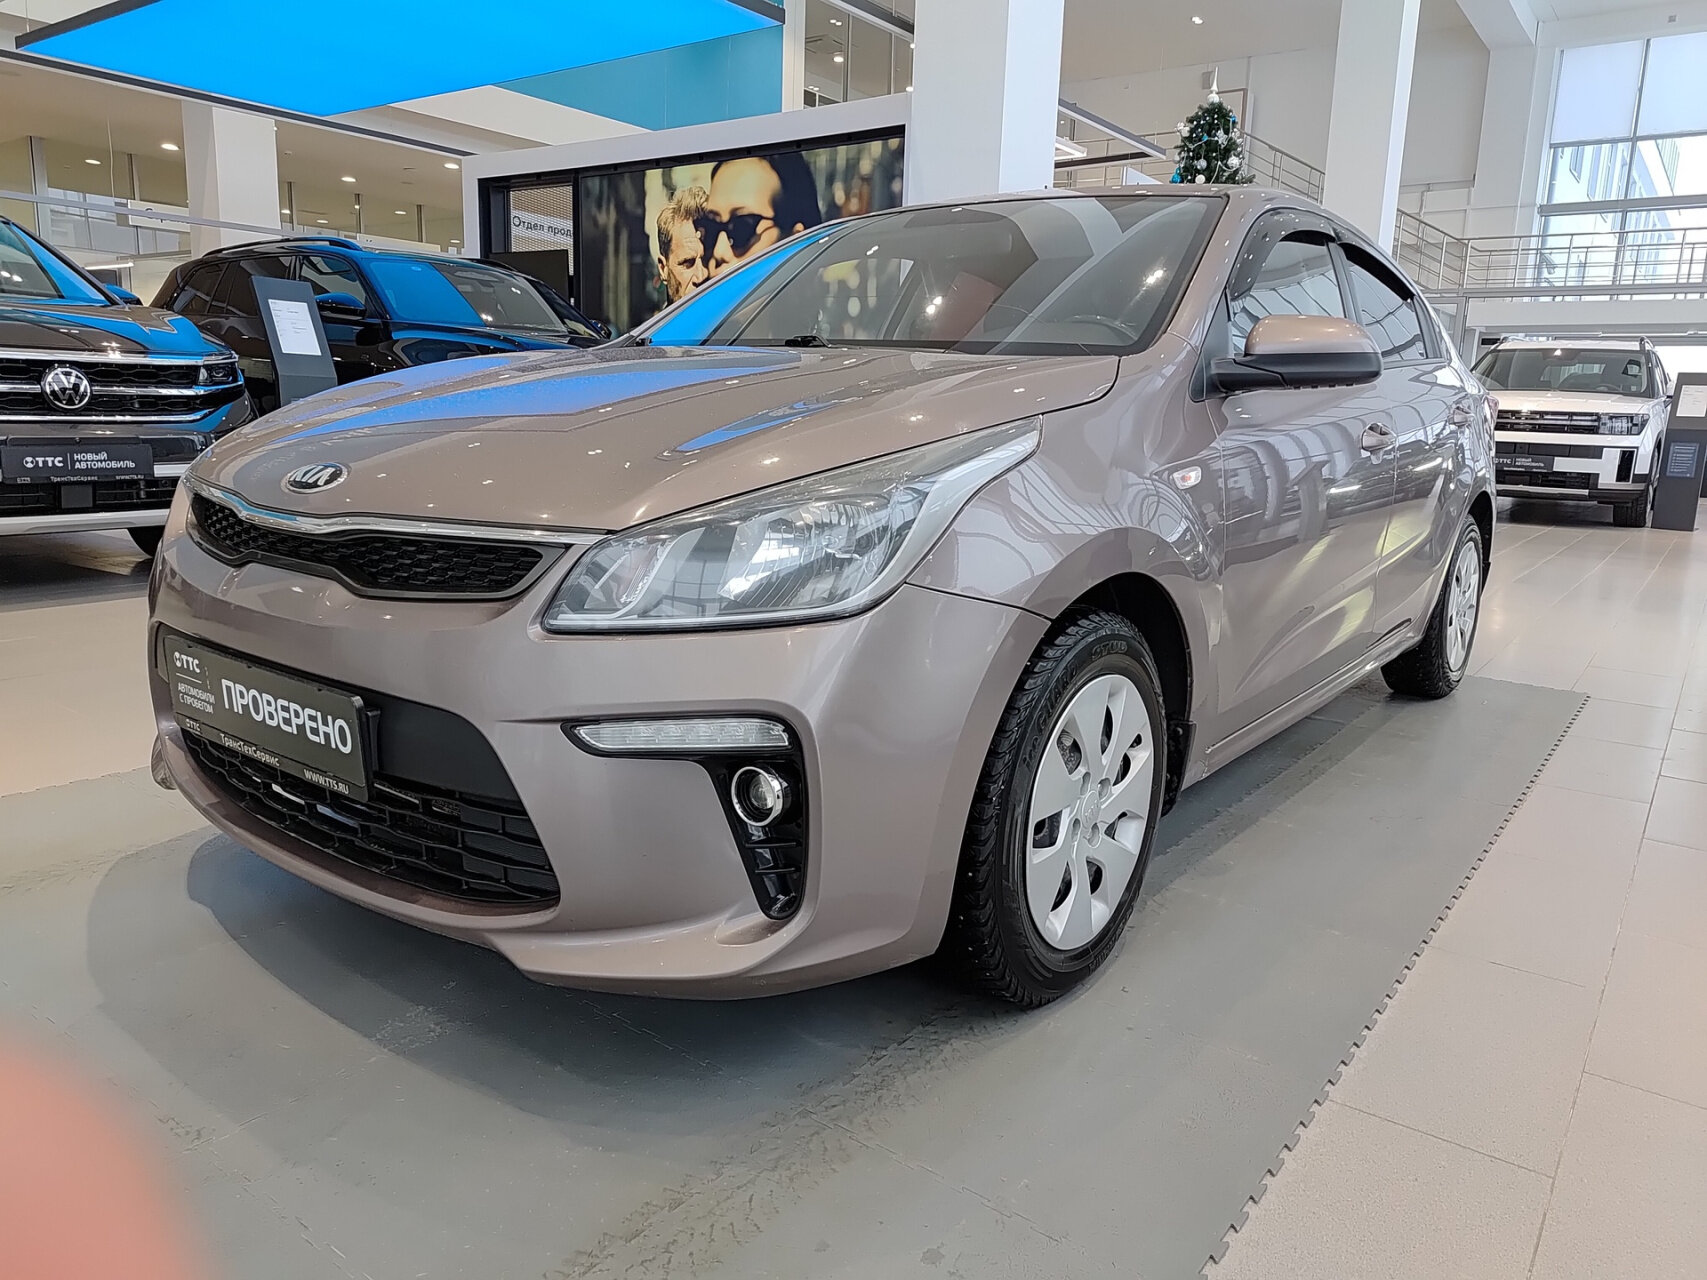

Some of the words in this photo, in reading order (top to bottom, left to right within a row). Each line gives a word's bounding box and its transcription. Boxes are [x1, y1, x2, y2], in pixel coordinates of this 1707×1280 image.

[513, 216, 544, 231] Отдел
[35, 456, 64, 467] ТТС
[73, 451, 108, 460] НОВЫЙ
[74, 461, 136, 469] АВТОМОБИЛЬ
[289, 464, 336, 486] KIA
[1091, 640, 1128, 661] STUD
[180, 654, 200, 673] ТТС
[178, 682, 216, 704] АВТОМОБИЛИ
[184, 694, 214, 714] ПРОБЕГОМ
[221, 678, 352, 754] ПРОВЕРЕНО
[220, 733, 280, 767] ТрансТехСервис
[304, 768, 350, 794] WWW.TTS.RU
